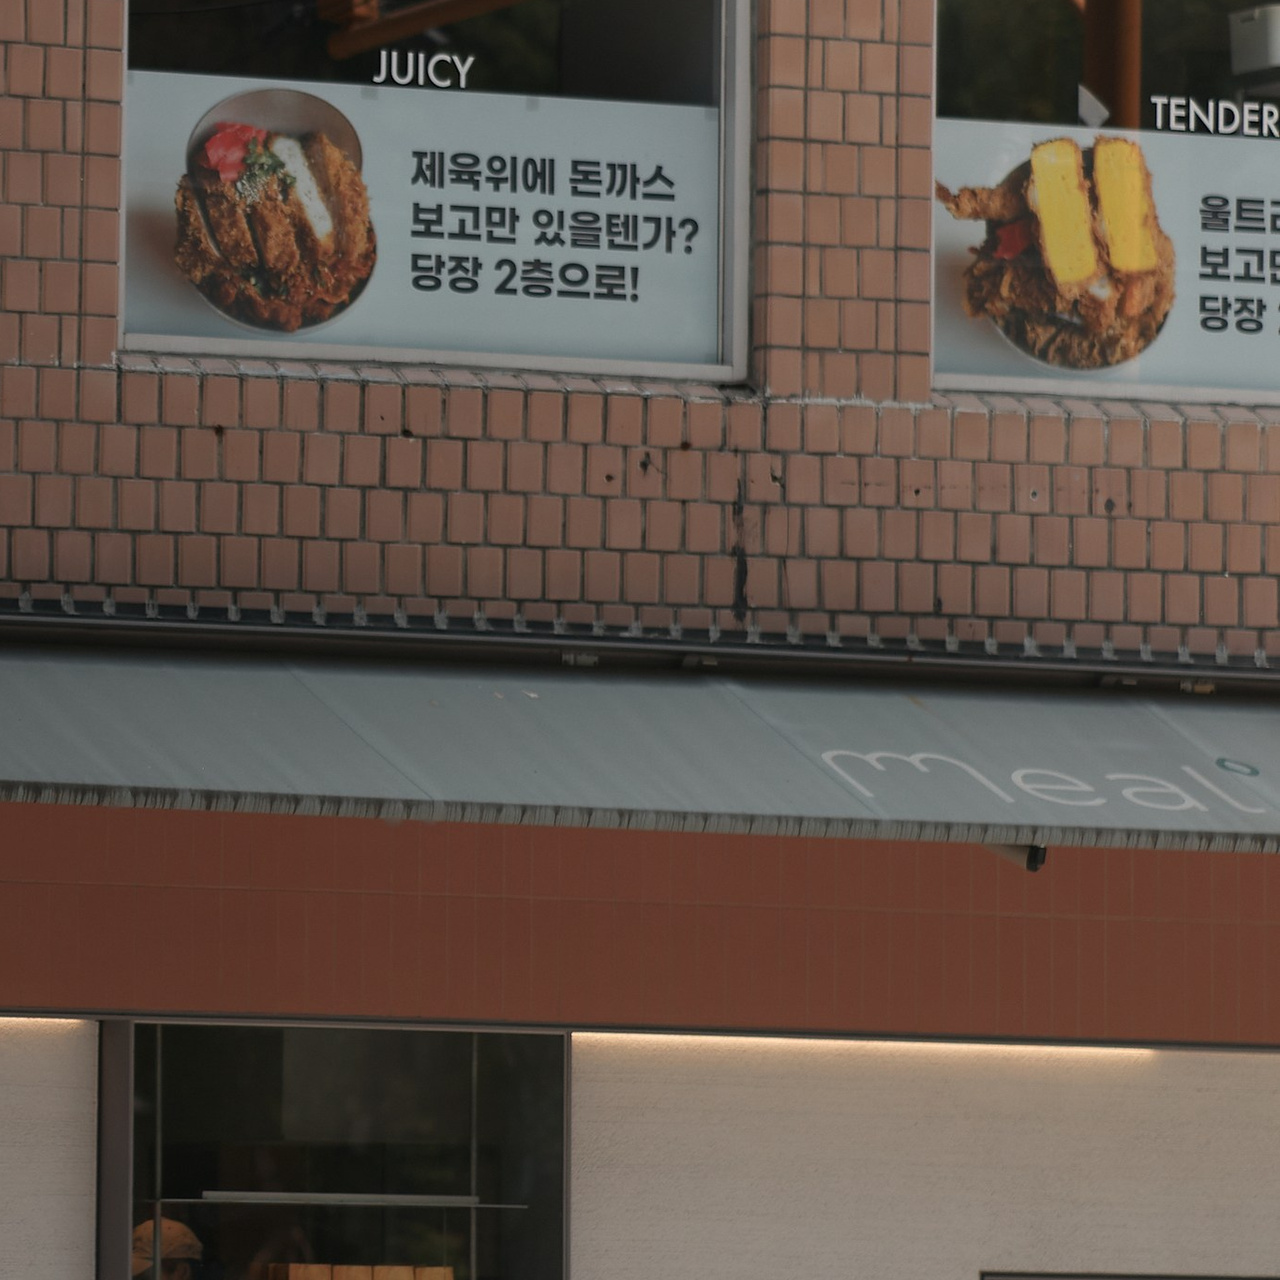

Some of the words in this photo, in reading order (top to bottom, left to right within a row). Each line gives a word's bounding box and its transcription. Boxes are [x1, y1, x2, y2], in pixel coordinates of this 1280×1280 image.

[372, 49, 475, 89] JUICY
[410, 151, 555, 196] 제육위에
[569, 158, 676, 202] 돈까스
[410, 203, 519, 244] 보고만
[533, 210, 700, 254] 있을텐가?
[410, 255, 482, 295] 당장
[494, 258, 640, 302] 2층으로!
[1198, 295, 1266, 335] 당장
